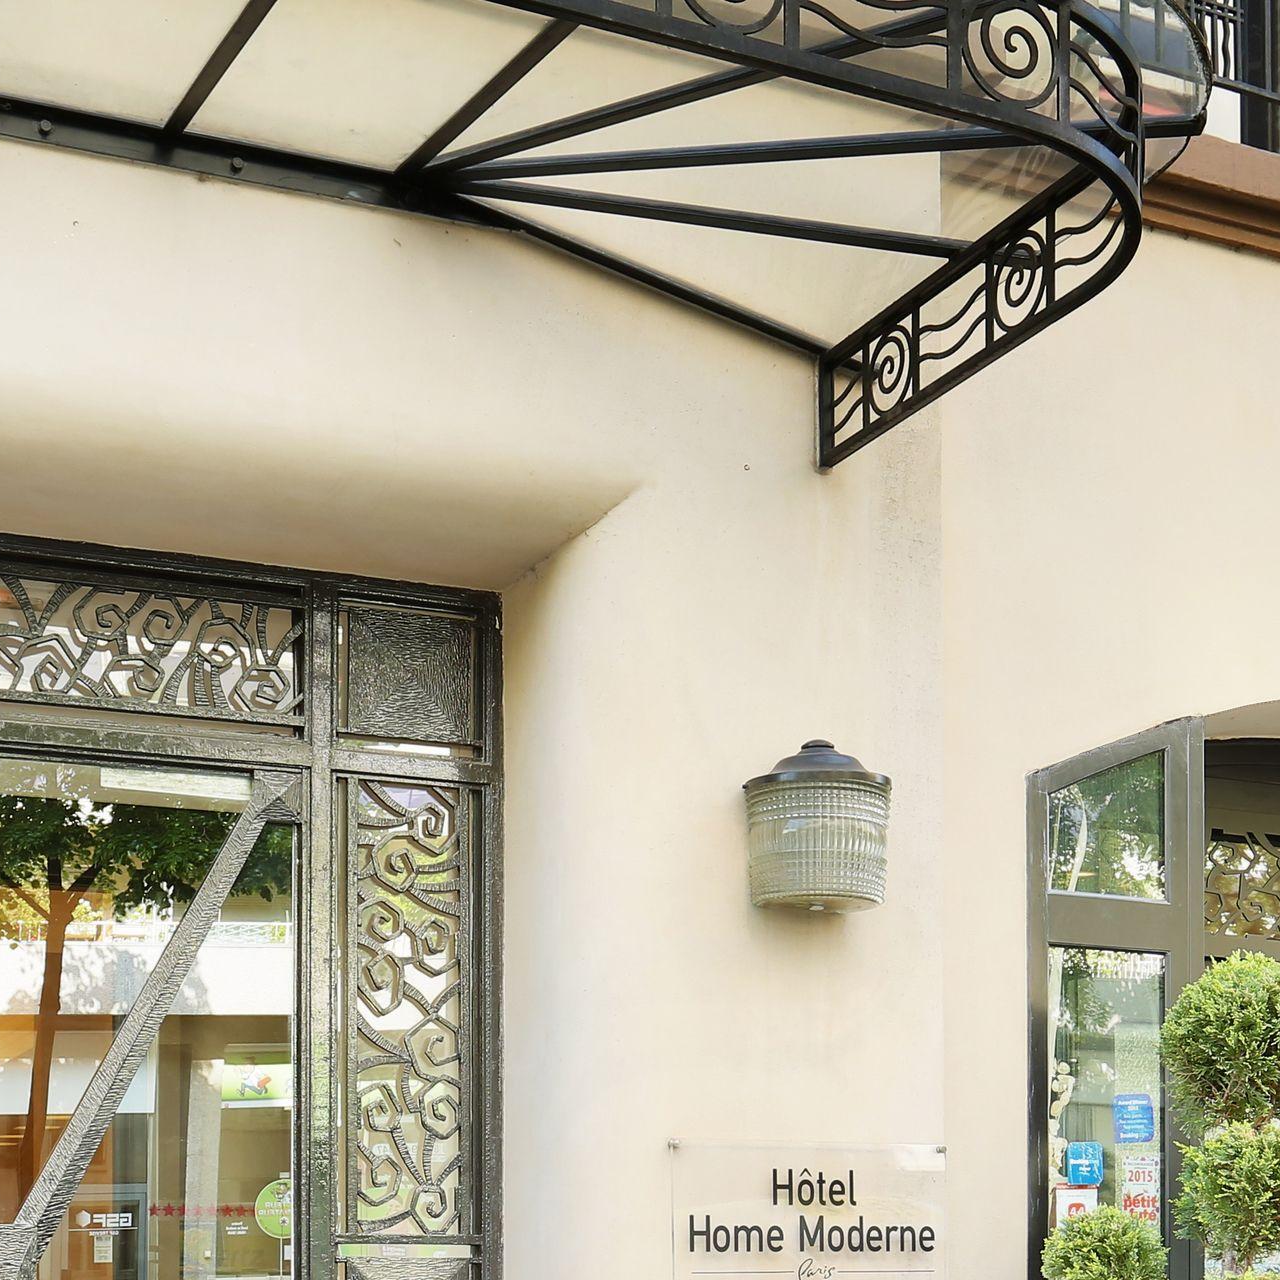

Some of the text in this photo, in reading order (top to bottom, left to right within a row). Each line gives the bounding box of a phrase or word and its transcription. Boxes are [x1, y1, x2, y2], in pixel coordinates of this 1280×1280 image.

[772, 1168, 857, 1207] Hôtel
[1128, 1170, 1153, 1182] 2015
[1123, 1194, 1157, 1211] petit
[689, 1215, 936, 1253] Home Moderne
